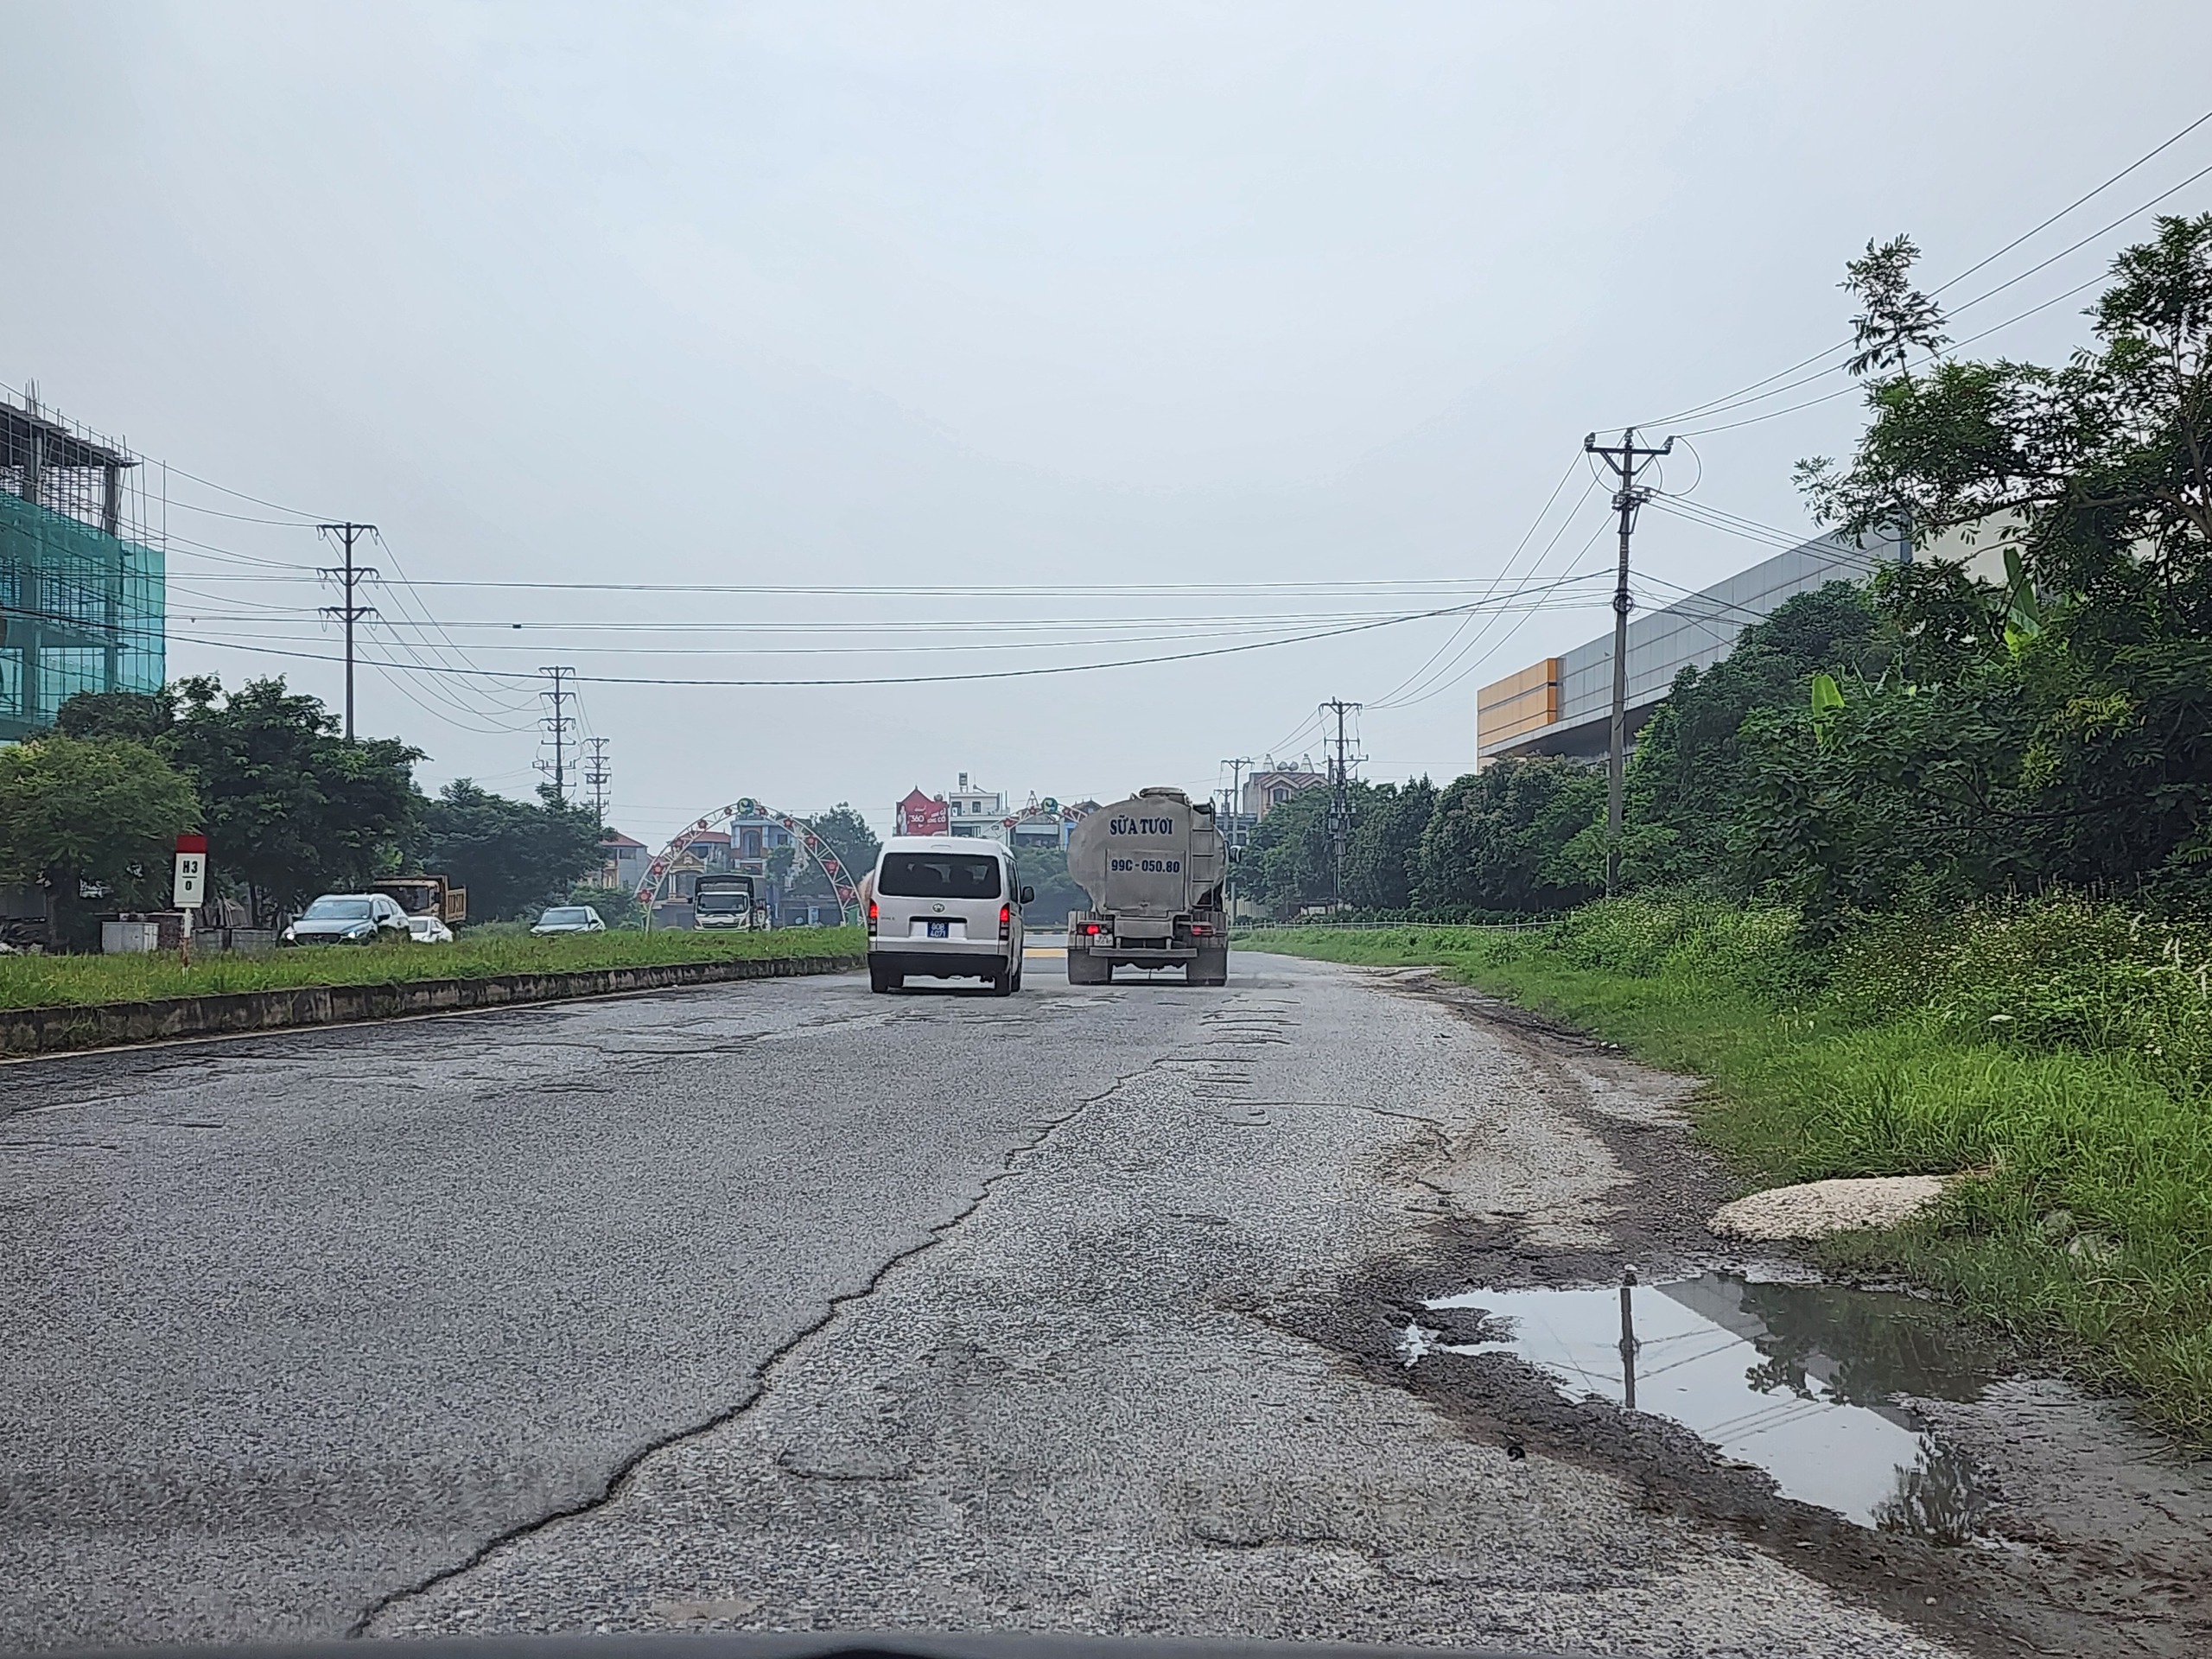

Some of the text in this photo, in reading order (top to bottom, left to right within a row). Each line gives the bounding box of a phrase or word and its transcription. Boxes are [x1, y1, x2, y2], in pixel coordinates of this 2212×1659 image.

[1109, 814, 1173, 836] SỮA TƯƠI
[182, 860, 198, 874] H3
